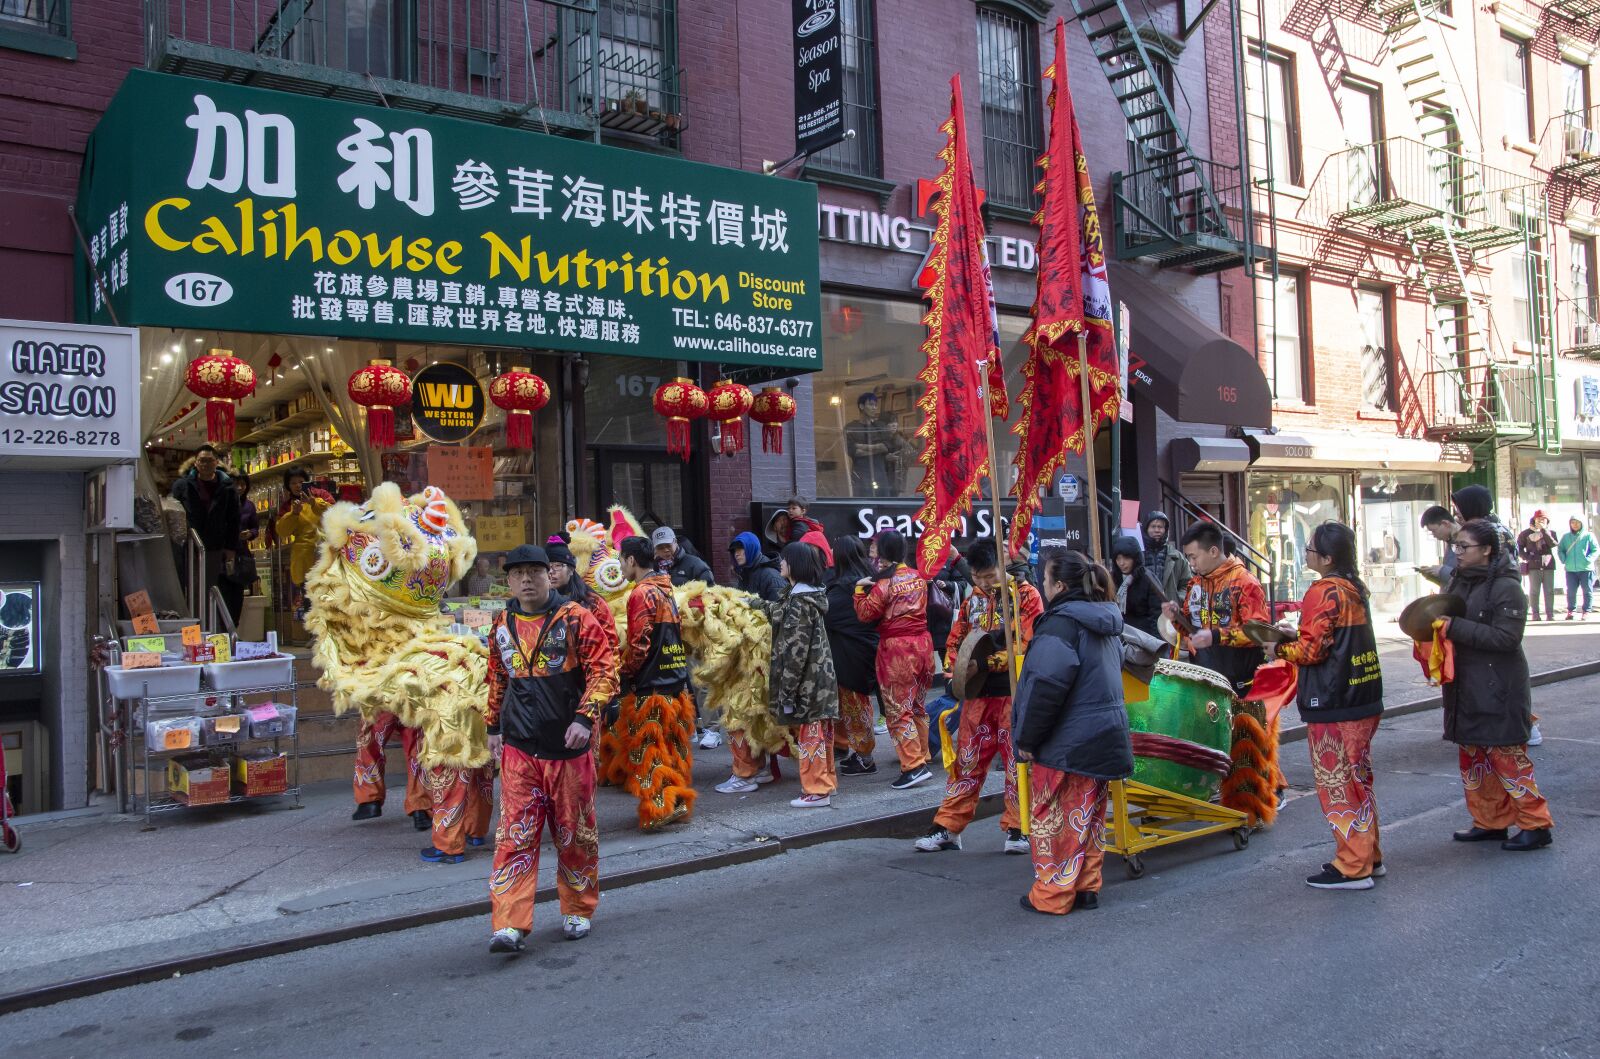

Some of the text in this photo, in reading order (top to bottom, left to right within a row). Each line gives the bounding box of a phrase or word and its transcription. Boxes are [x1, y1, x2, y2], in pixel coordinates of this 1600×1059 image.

[798, 35, 839, 68] Season
[808, 68, 831, 93] Spa
[807, 116, 825, 129] HESTER
[825, 108, 840, 121] STREET
[185, 94, 435, 217] 加利
[450, 158, 790, 255] 參茸海味特價城
[817, 202, 911, 250] TTING
[144, 197, 731, 305] Calihouse Nutrition
[1001, 235, 1039, 271] ED
[175, 278, 223, 302] 167
[738, 271, 806, 295] Discount
[752, 291, 793, 312] Store
[671, 307, 814, 338] TEL: 646-837-6377
[12, 340, 106, 377] HAIR
[673, 335, 817, 359] www.calihouse.care
[615, 374, 661, 398] 167
[1134, 368, 1153, 386] EDGE
[0, 380, 117, 418] SALON
[418, 383, 474, 409] WU
[1217, 386, 1238, 403] 165
[424, 410, 474, 419] WESTERN
[440, 419, 474, 427] UNION
[1, 428, 121, 446] 12-226-8278
[1284, 446, 1304, 457] SOLO
[858, 508, 967, 540] Seasn
[892, 579, 925, 596] UNITED
